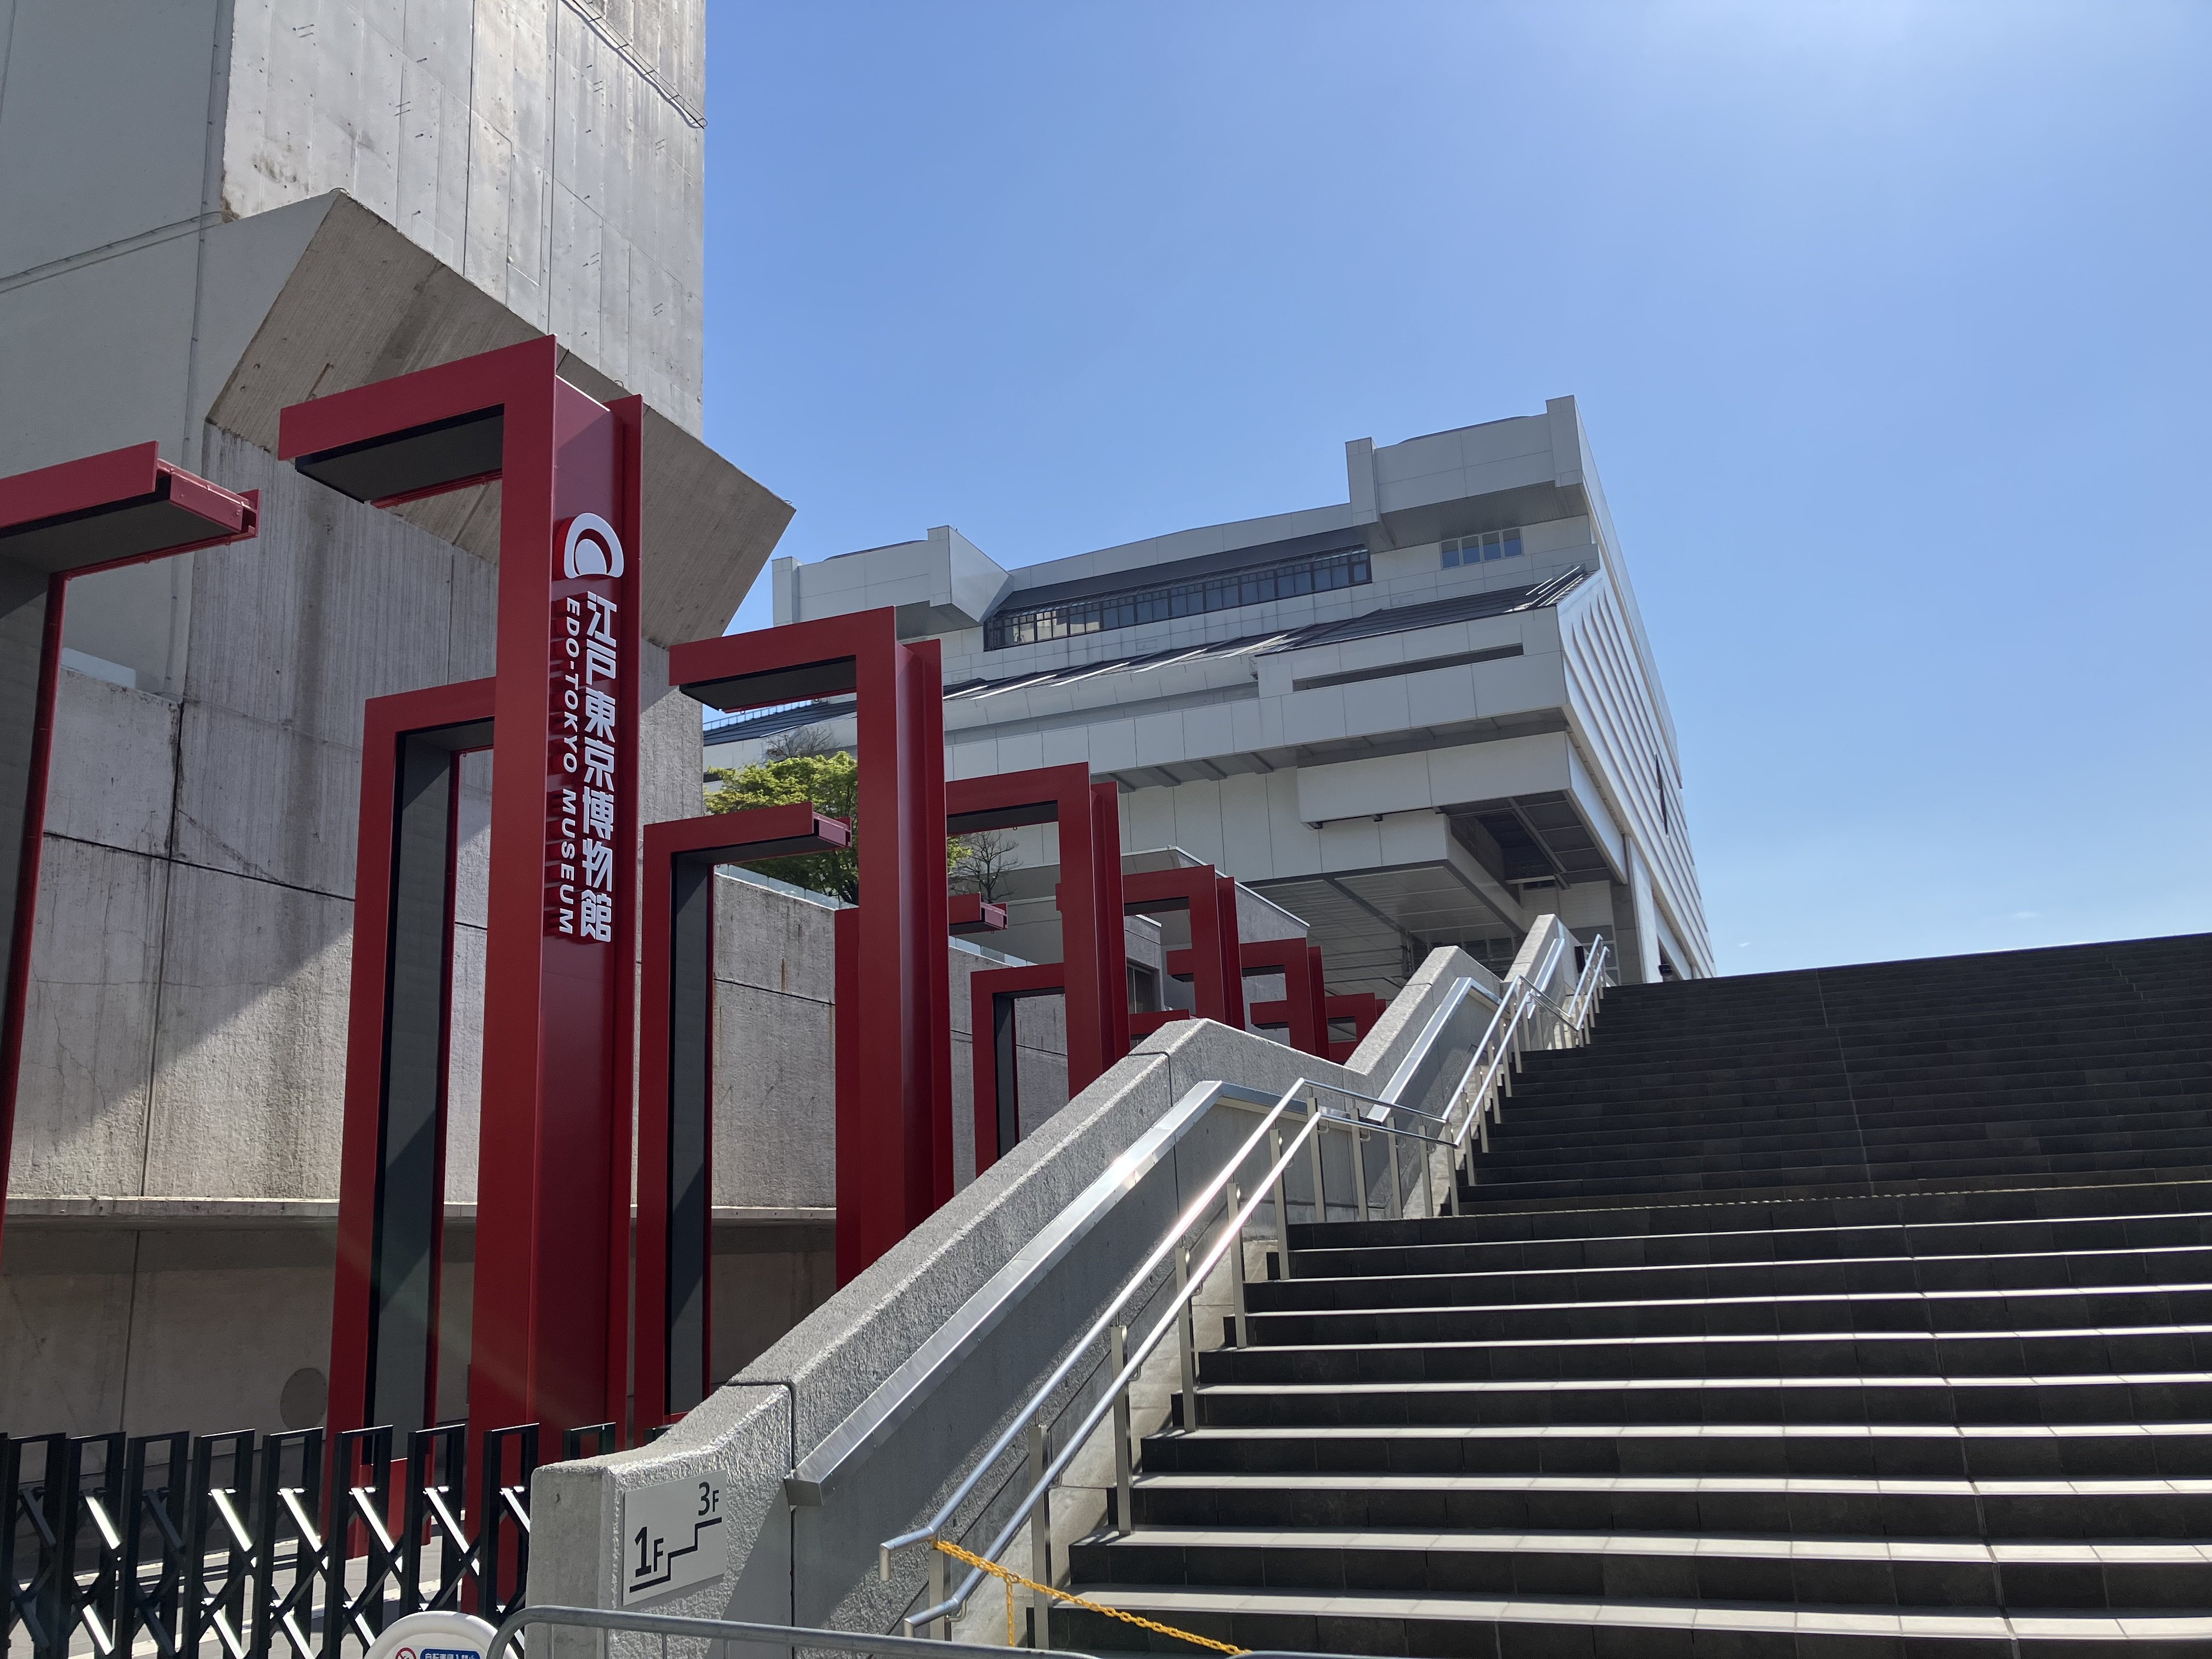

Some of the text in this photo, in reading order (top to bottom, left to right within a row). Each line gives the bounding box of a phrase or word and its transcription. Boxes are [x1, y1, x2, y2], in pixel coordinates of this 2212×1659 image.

[559, 597, 580, 934] EDO-TOKYO MUSEUM
[580, 590, 617, 943] 江戸東京博物館
[634, 1526, 664, 1578] 1F
[698, 1481, 719, 1516] 3F
